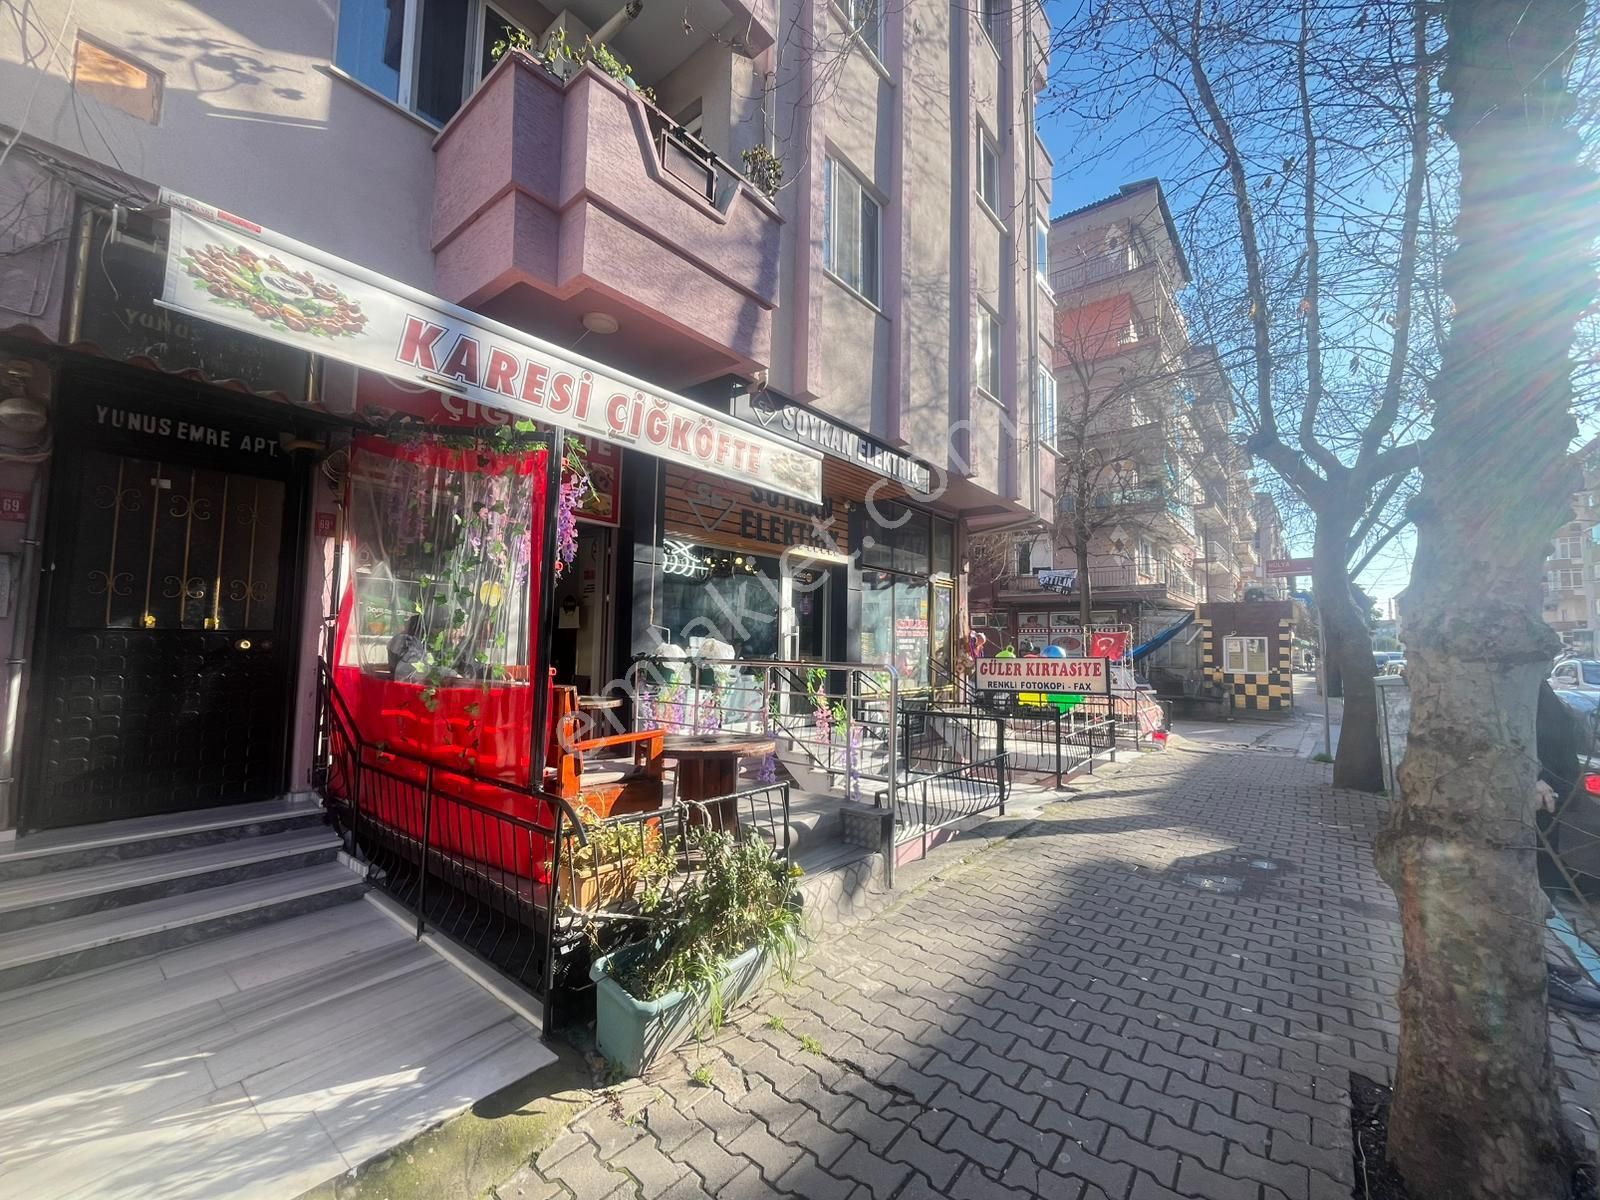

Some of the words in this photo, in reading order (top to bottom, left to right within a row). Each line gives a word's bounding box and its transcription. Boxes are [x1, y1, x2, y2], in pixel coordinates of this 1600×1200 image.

[396, 314, 594, 421] KARESİ
[605, 389, 762, 476] ÇİĞKÖFTE
[96, 405, 171, 435] YUNUS
[177, 422, 231, 447] EMRE
[240, 436, 278, 457] APT.
[782, 404, 852, 457] SOYKAN
[980, 660, 1021, 676] GÜLER
[1073, 682, 1092, 691] FAX
